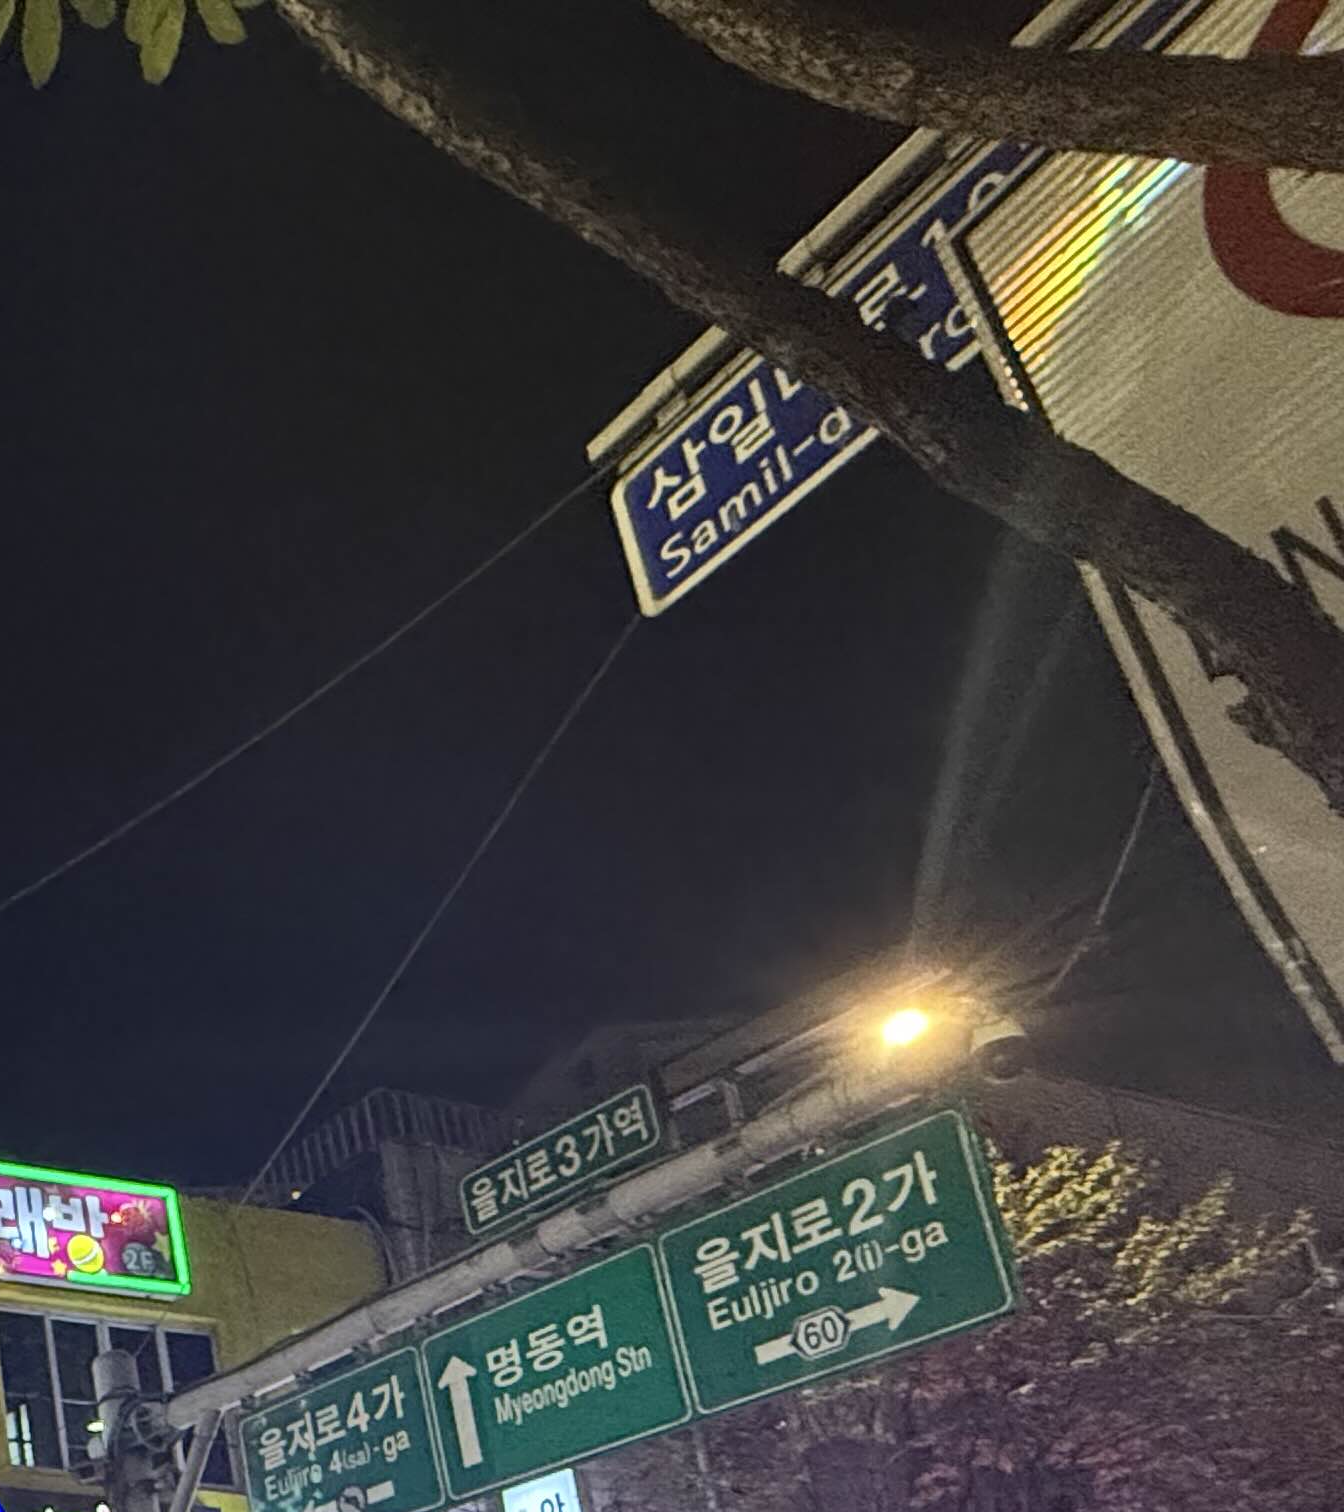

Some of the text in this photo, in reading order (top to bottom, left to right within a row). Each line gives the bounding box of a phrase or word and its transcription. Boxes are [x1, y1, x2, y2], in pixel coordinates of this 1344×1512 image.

[647, 262, 927, 522] 삼일로
[660, 302, 980, 579] Samil-dro
[469, 1099, 650, 1225] 을지로3가역
[693, 1150, 939, 1296] 을지로2가
[709, 1222, 950, 1331] Euljiro 2(i)-ga
[485, 1305, 610, 1386] 명동역
[804, 1318, 840, 1348] 60
[257, 1374, 408, 1465] 을지로4가
[494, 1342, 652, 1428] Myeongdong Stn
[264, 1429, 412, 1503] Euljiro 4(sa)-ga
